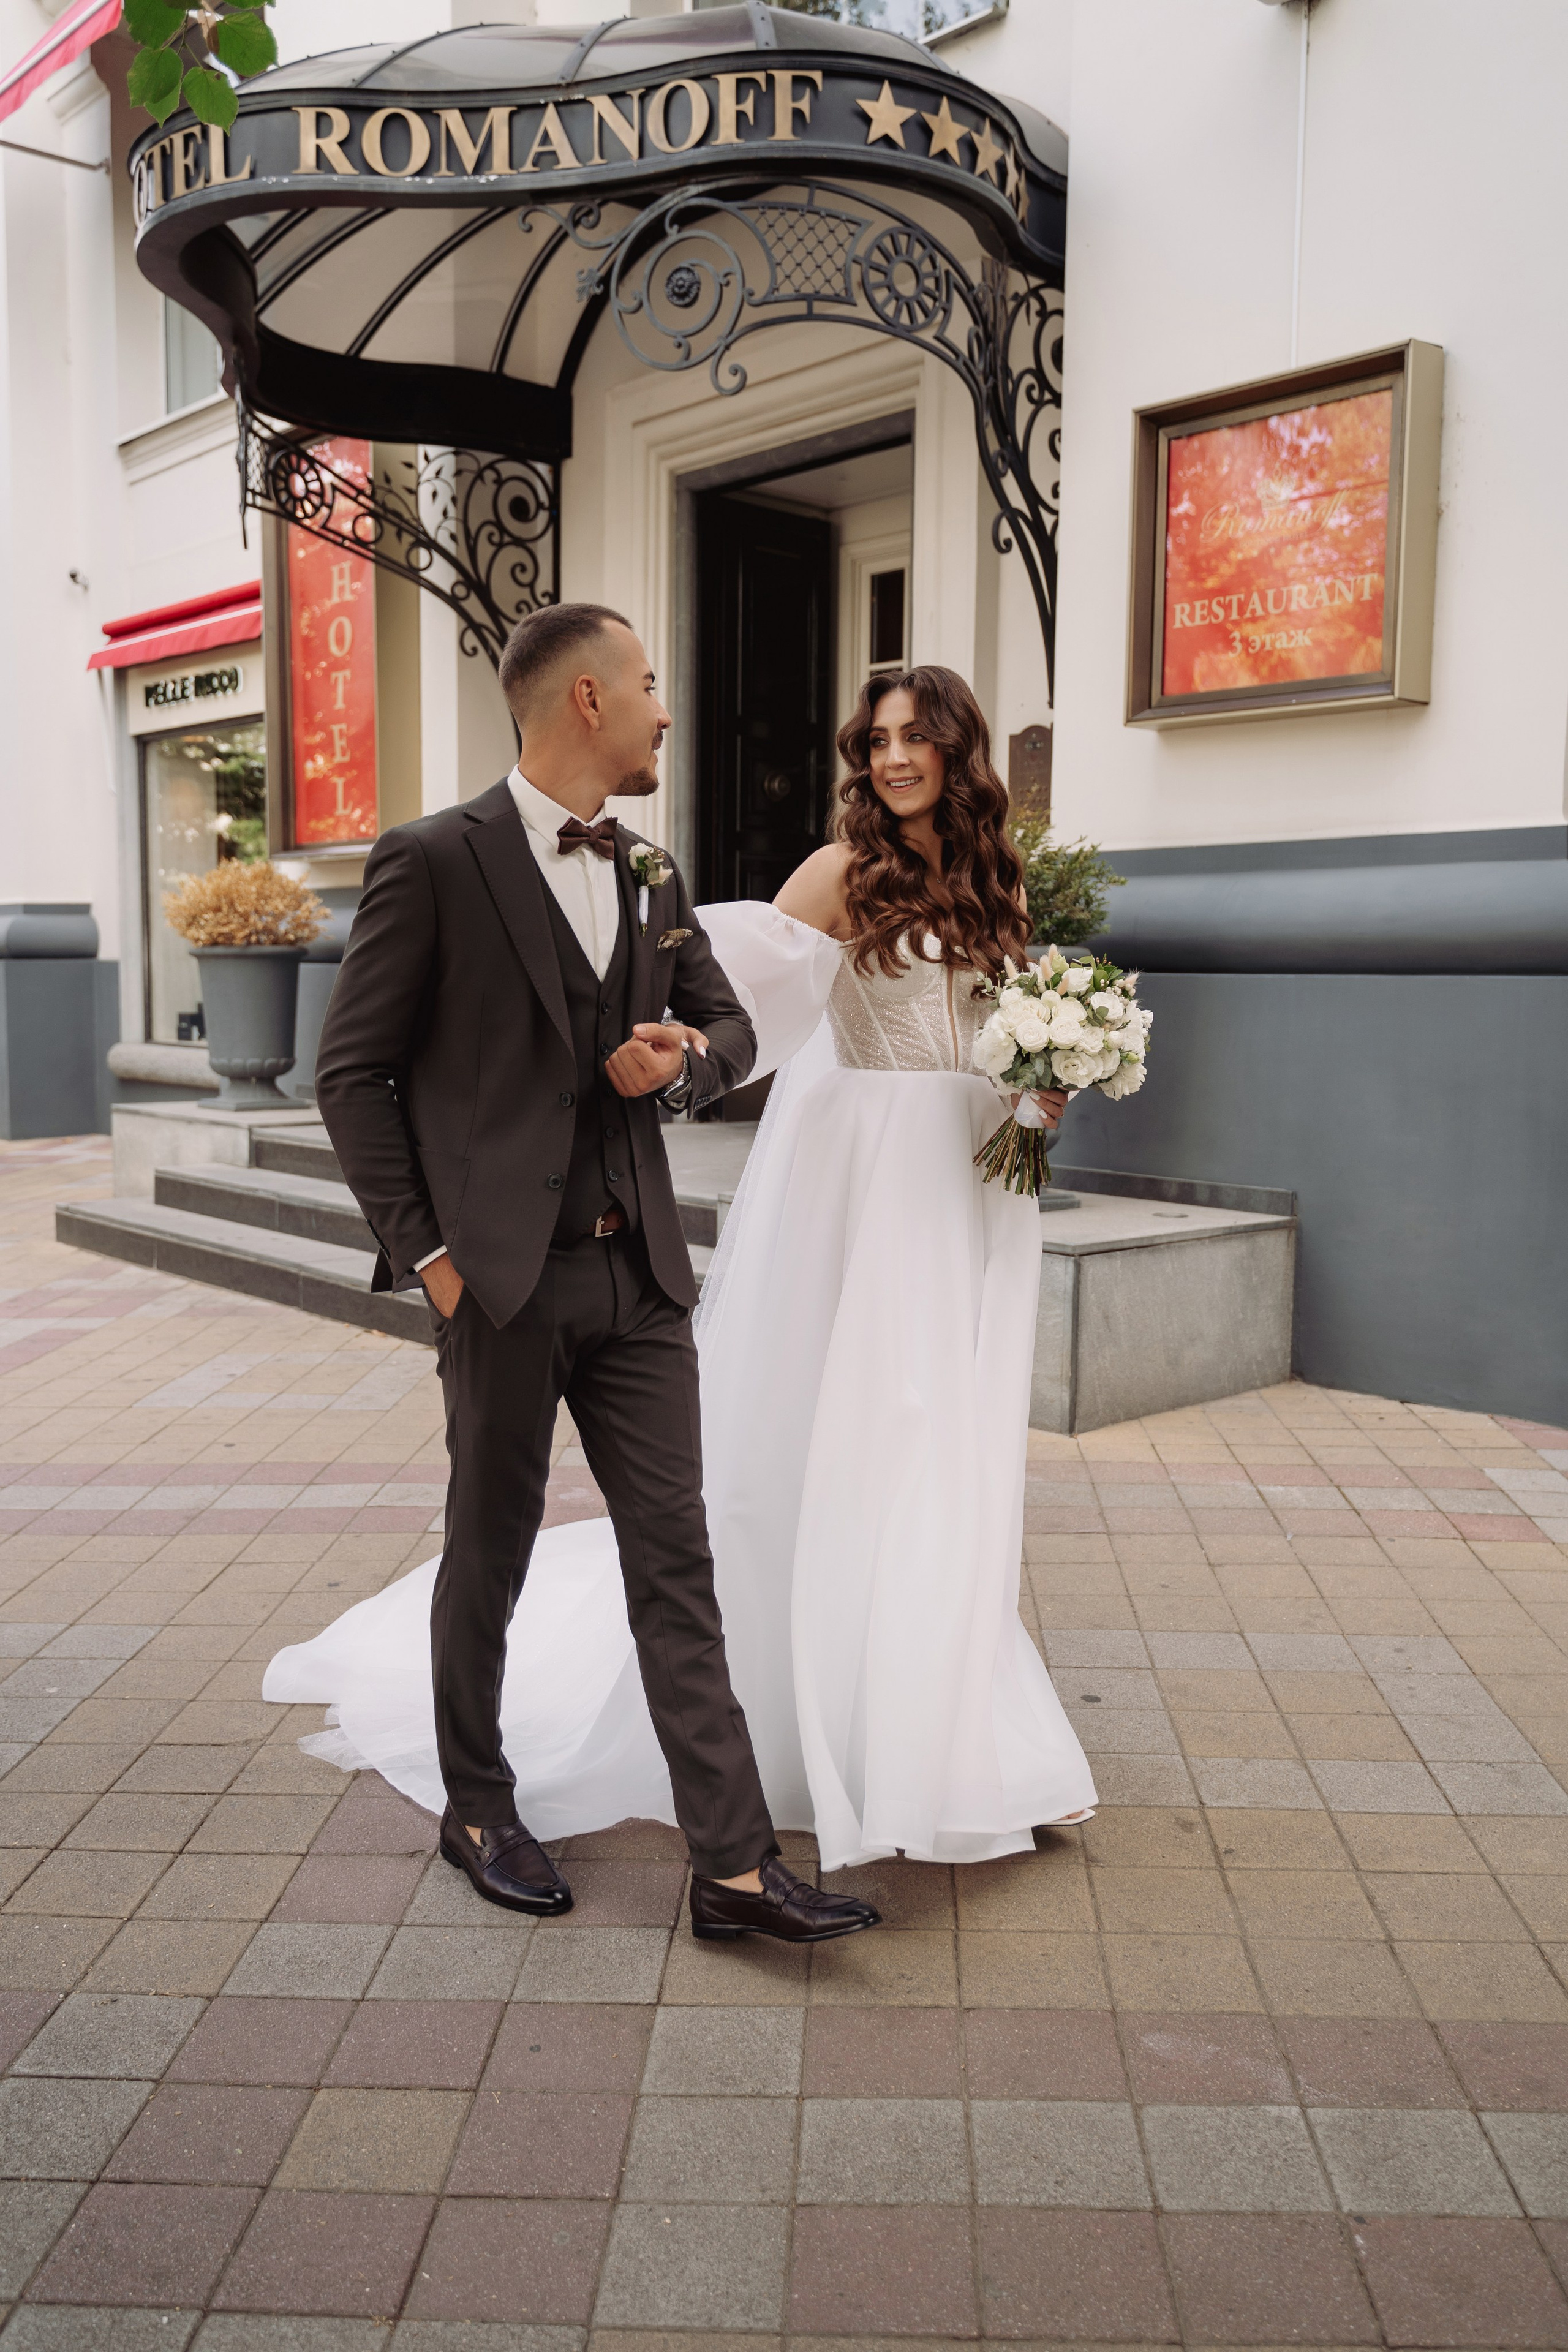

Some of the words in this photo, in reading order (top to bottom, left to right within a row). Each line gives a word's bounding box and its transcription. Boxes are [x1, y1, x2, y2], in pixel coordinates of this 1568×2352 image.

[292, 70, 823, 177] ROMANOFF
[1172, 573, 1378, 629] RESTAURANT
[1228, 631, 1243, 658] 3
[1248, 628, 1313, 654] этаж
[328, 560, 353, 816] HOTEL
